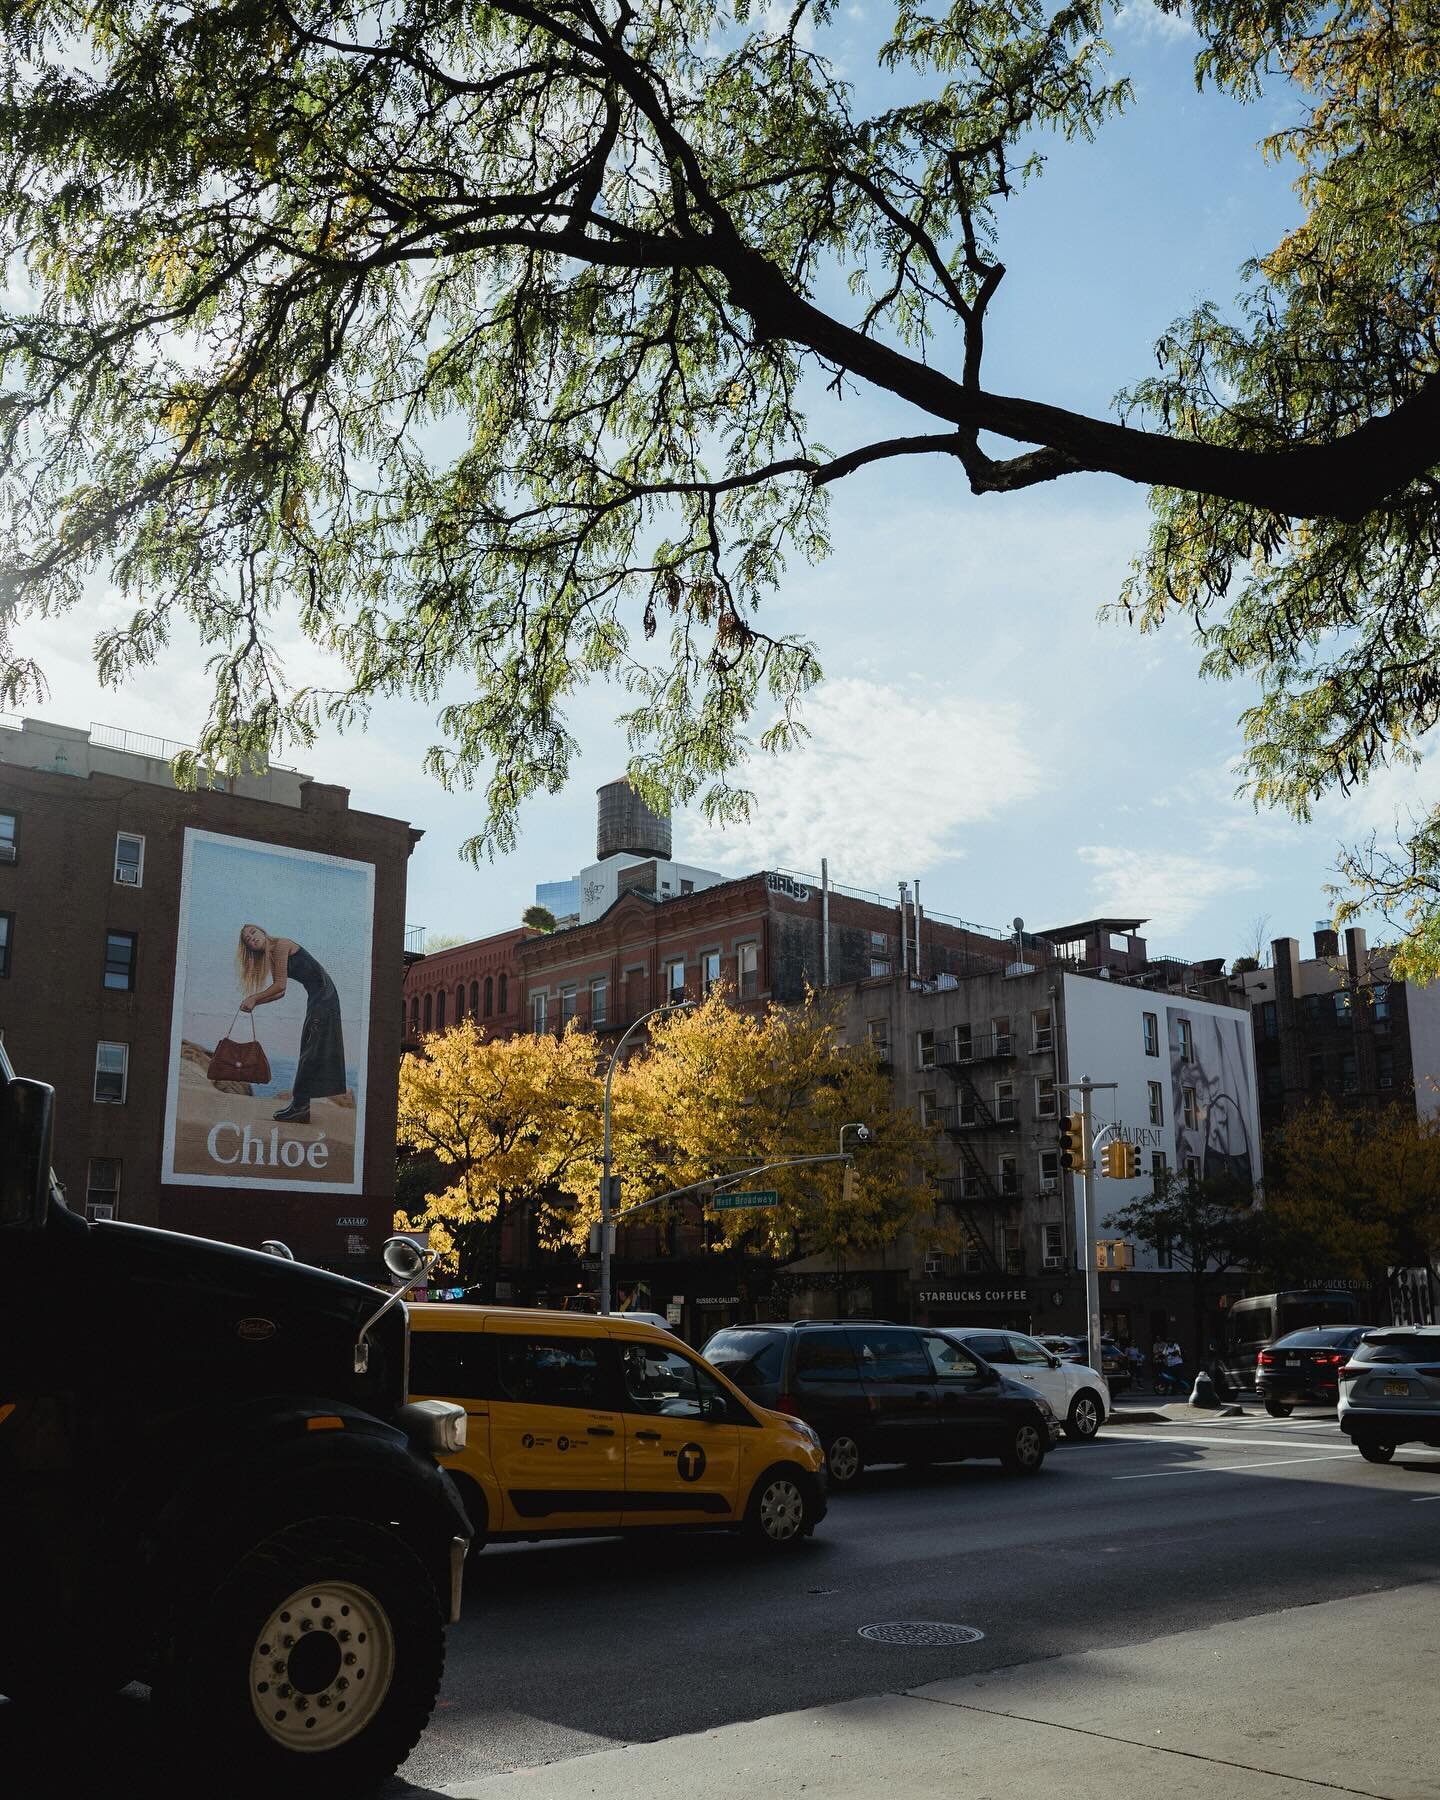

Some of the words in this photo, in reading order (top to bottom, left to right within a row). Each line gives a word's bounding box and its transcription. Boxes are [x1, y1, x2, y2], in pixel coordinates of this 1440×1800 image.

[207, 1121, 329, 1169] Chloé
[735, 1194, 774, 1205] Broadway
[919, 1291, 982, 1302] STARBUCKS
[984, 1290, 1028, 1301] COFFEE
